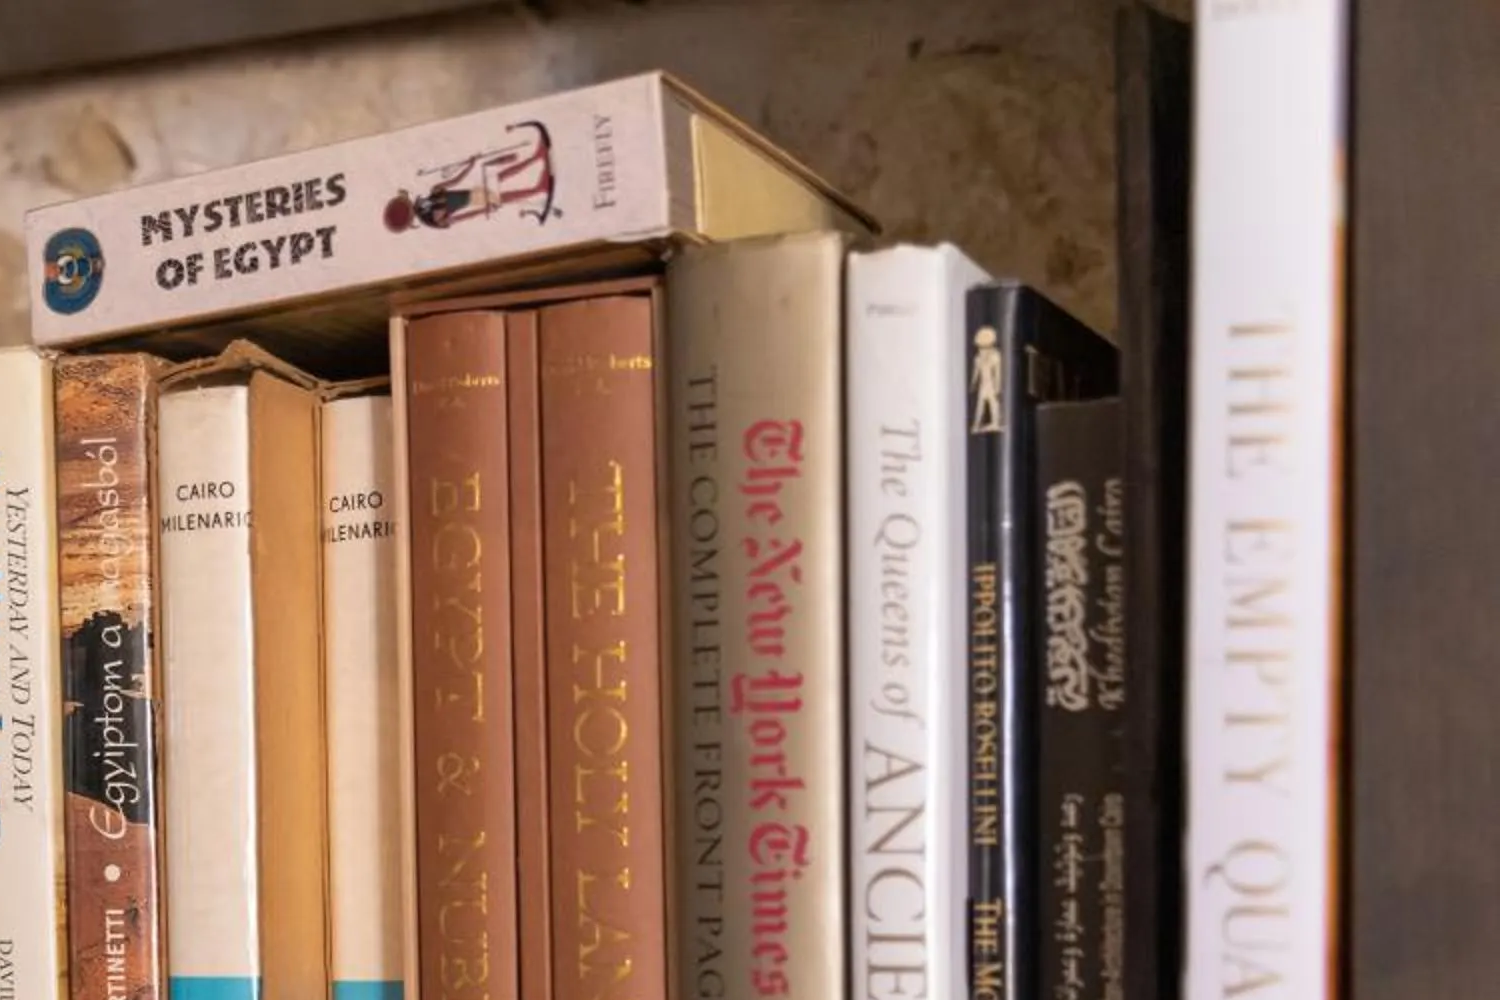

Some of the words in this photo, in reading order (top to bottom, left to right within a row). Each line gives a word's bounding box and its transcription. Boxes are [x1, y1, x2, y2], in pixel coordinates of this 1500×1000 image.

[140, 173, 348, 246] MYSTERIES
[592, 112, 618, 212] FIREFLY
[155, 254, 204, 291] OF
[214, 226, 340, 282] EGYPT
[687, 364, 721, 466] THE
[878, 418, 924, 500] The
[1224, 319, 1298, 478] THE
[175, 481, 236, 502] CAIRO
[328, 490, 385, 514] CAIRO
[738, 419, 805, 525] The
[4, 487, 31, 640] YESTERDAY
[431, 472, 483, 723] EGYPT
[568, 459, 625, 620] THE
[740, 538, 805, 659] New
[872, 511, 924, 668] Queens
[99, 624, 123, 649] a
[690, 475, 723, 728] COMPLETE
[971, 562, 996, 695] IPPOLITO
[1222, 515, 1298, 797] EMPTY
[8, 645, 34, 705] AND
[869, 681, 928, 728] of
[10, 714, 36, 814] TODAY
[88, 658, 140, 841] Egyiptom
[435, 752, 482, 797] &
[571, 640, 628, 848] HOLY
[730, 671, 807, 813] York
[972, 702, 998, 846] ROSELLINI
[692, 742, 725, 904] FRONT
[746, 820, 811, 999] Times
[973, 898, 1003, 956] THE
